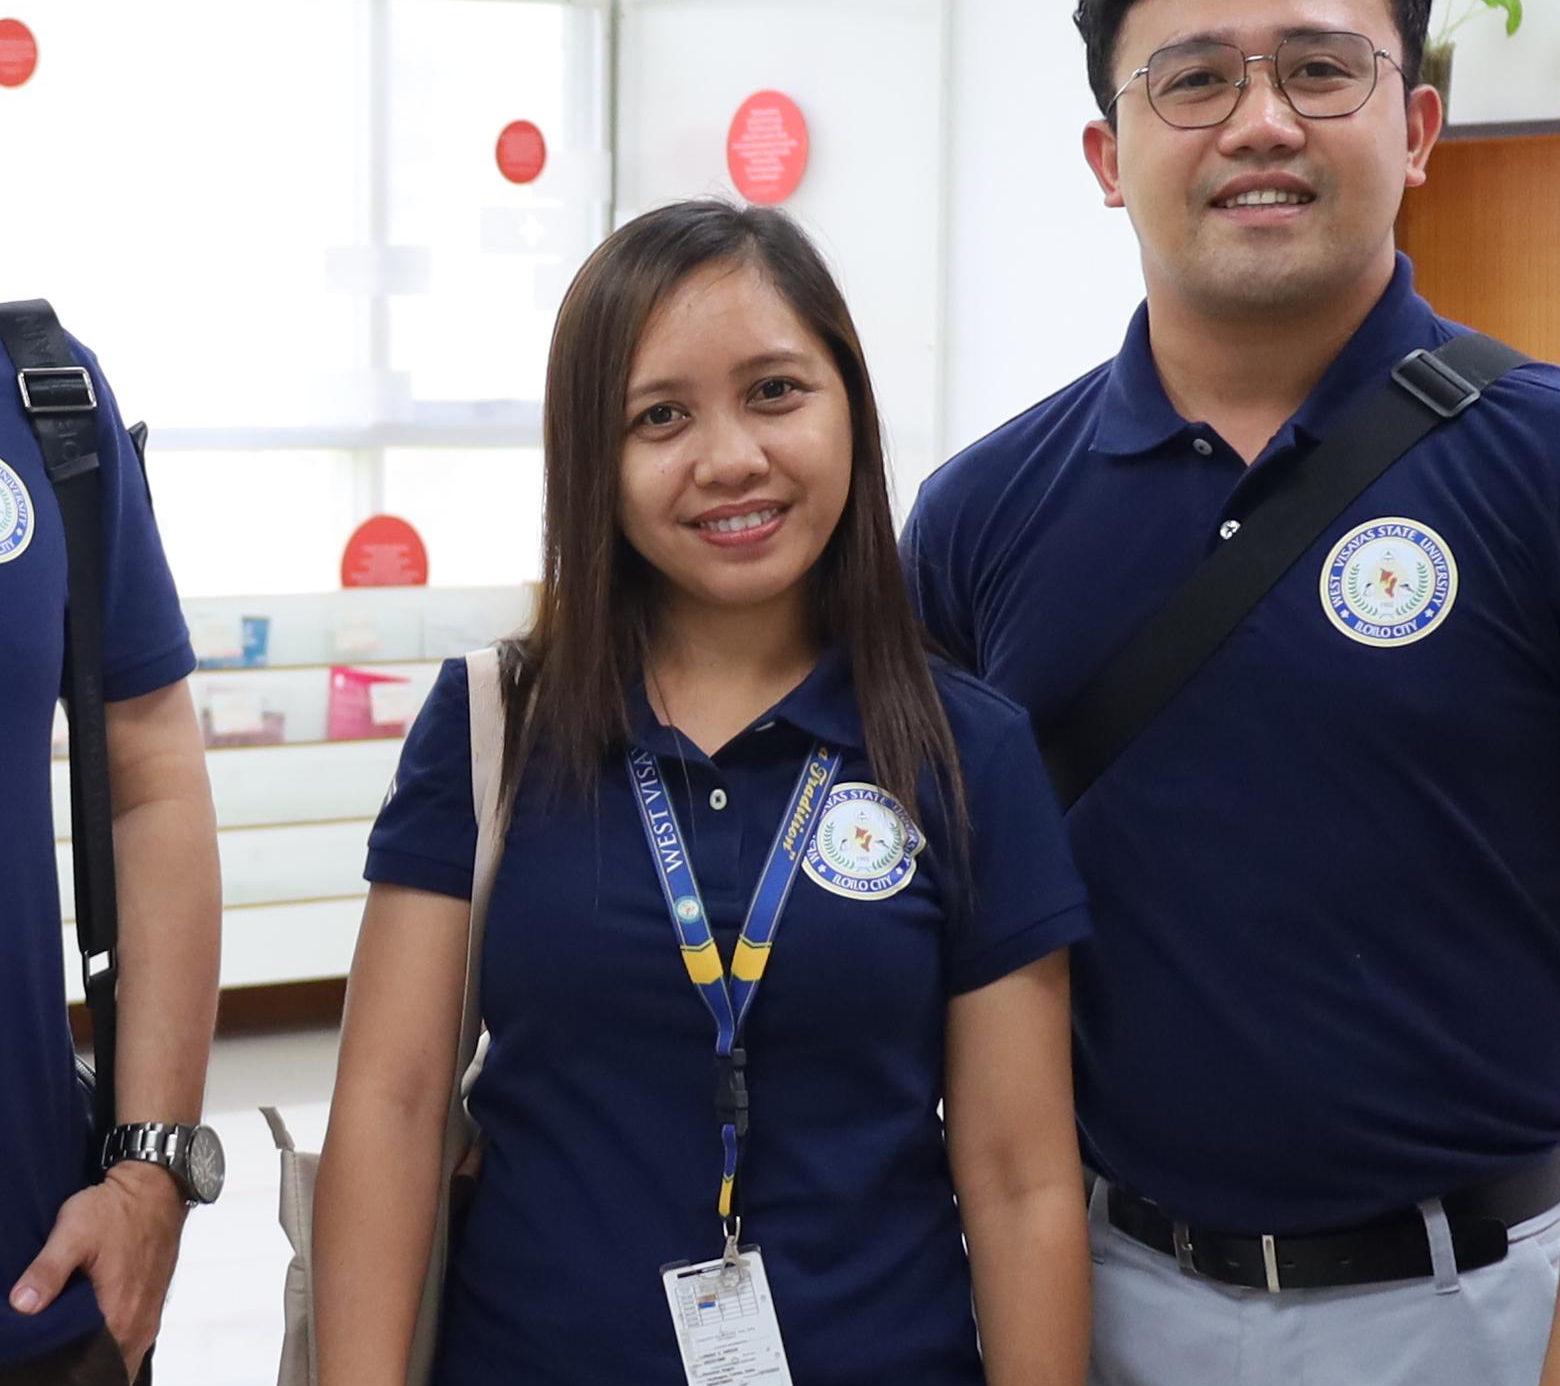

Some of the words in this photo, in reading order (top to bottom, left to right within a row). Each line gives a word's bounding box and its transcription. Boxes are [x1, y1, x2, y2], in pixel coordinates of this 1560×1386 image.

[1334, 528, 1376, 568] VISAYAS
[1377, 525, 1417, 541] STATE
[1420, 538, 1449, 607] UNIVERSITY
[1329, 575, 1344, 608] WEST
[1354, 620, 1391, 638] ILOILO
[1393, 620, 1418, 637] CITY
[632, 751, 662, 805] VISA
[850, 791, 886, 805] STATE
[648, 809, 683, 873] WEST
[832, 874, 869, 891] ILOILO
[870, 875, 893, 891] CITY
